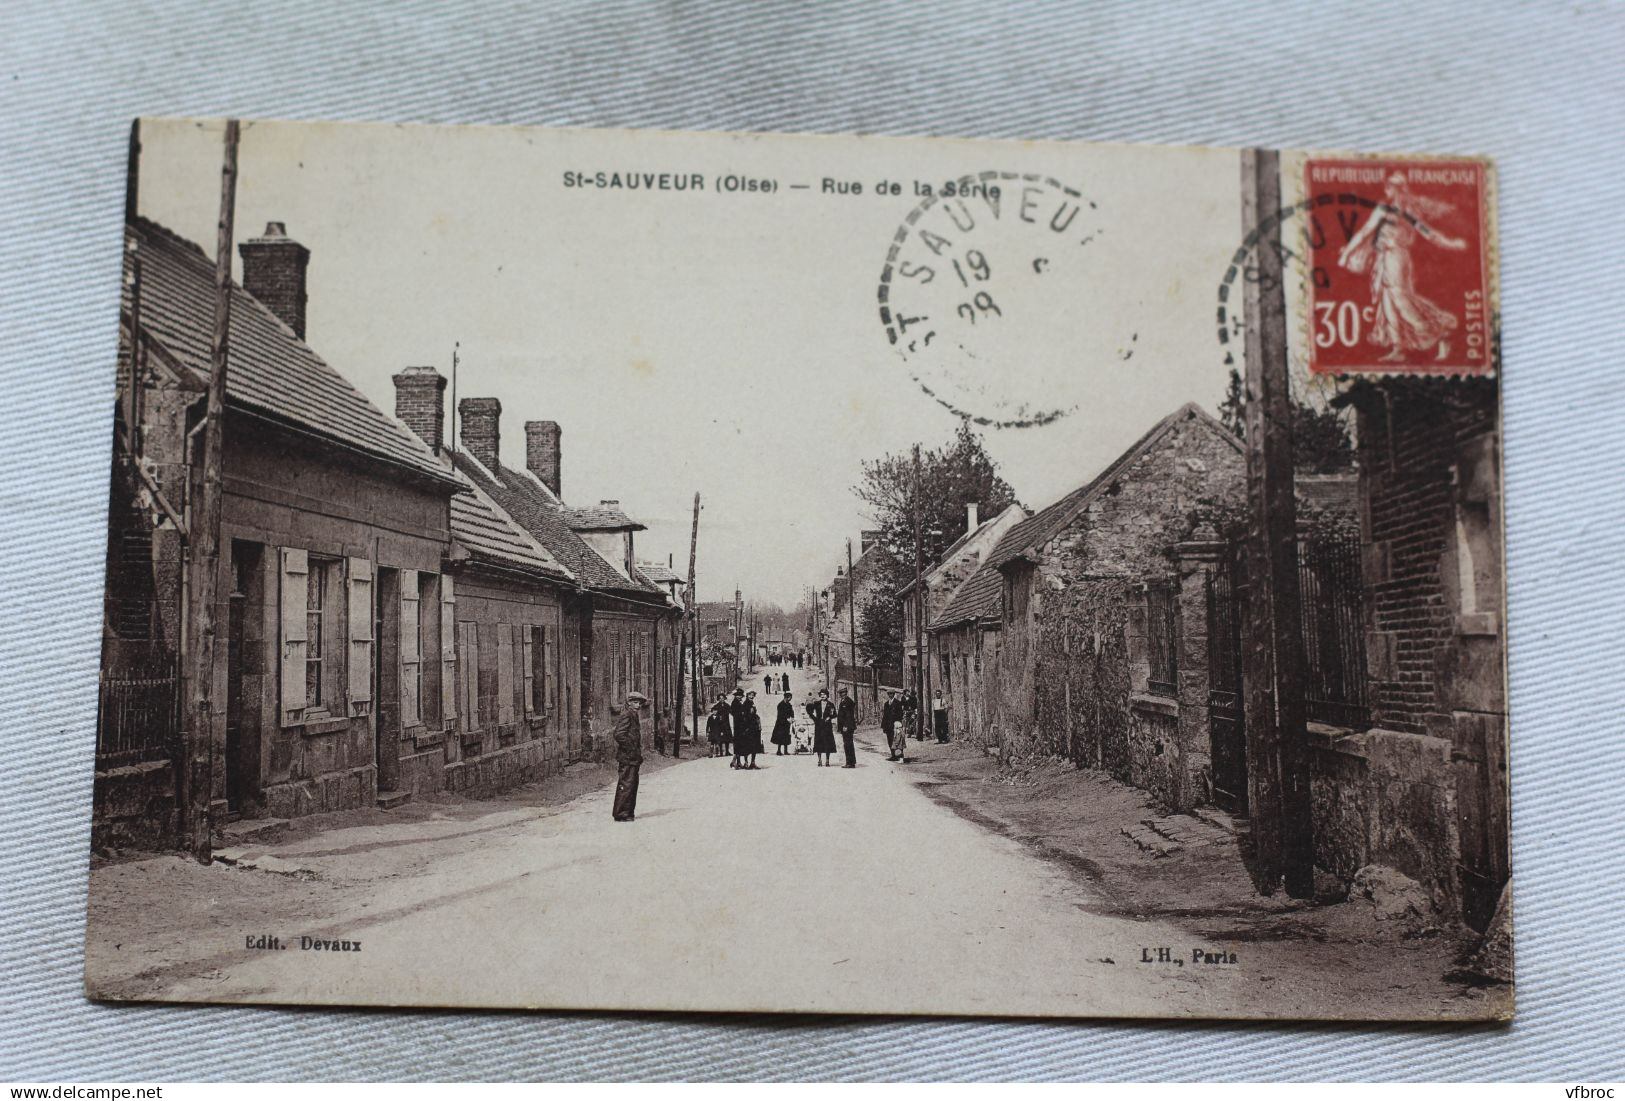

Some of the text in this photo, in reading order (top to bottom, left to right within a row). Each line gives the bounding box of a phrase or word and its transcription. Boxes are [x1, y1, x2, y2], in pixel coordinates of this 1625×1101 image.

[563, 171, 705, 191] St-SAUVEUR
[821, 177, 863, 196] Rue
[876, 179, 903, 195] de
[913, 180, 932, 196] la
[1464, 289, 1483, 360] POSTES
[245, 935, 362, 952] Edit. Devaux
[1192, 949, 1239, 964] Paris
